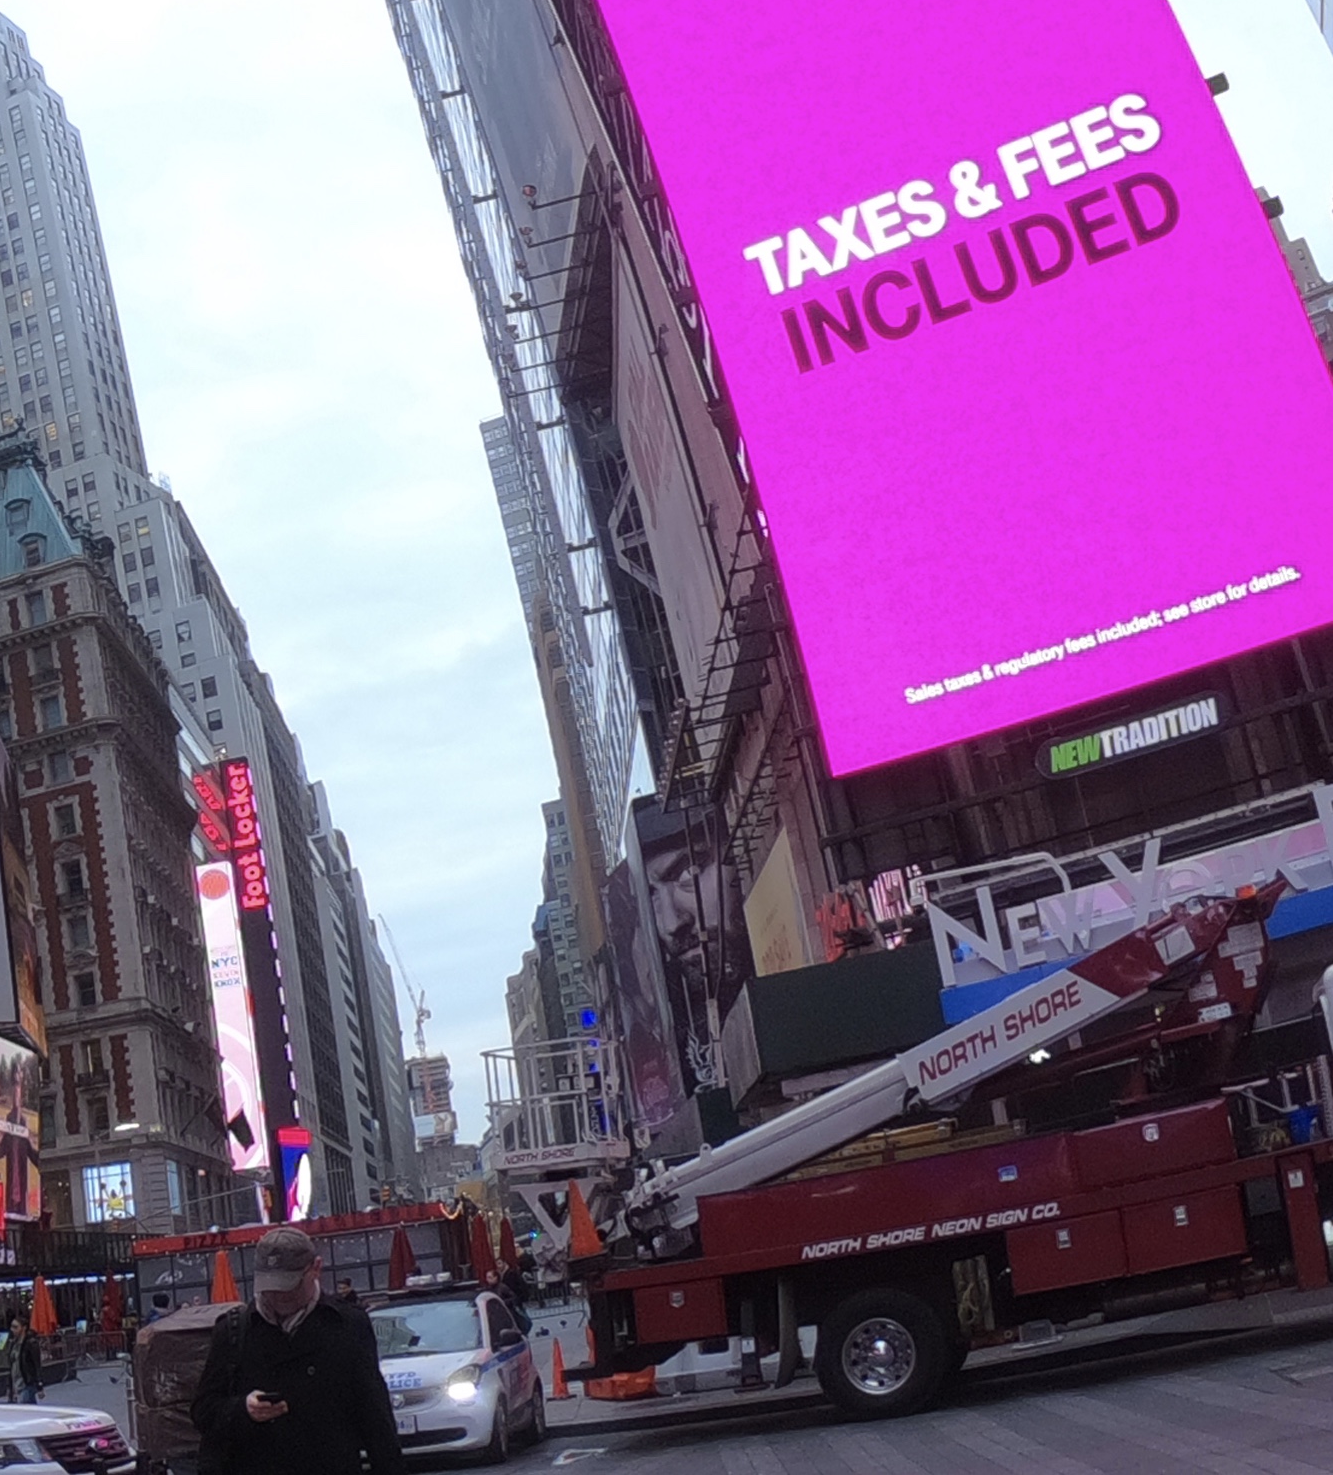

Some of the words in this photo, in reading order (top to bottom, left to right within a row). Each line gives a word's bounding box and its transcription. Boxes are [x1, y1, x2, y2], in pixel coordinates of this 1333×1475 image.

[742, 179, 948, 296] TAXES
[949, 159, 1003, 219] &
[996, 93, 1162, 201] FEES
[780, 171, 1181, 375] INCLUDED
[903, 681, 945, 706] Sales
[944, 670, 982, 693] taxes
[981, 663, 995, 681] &
[994, 639, 1066, 677] regulatory
[1064, 633, 1097, 655] fees
[1162, 602, 1191, 623] see
[1190, 589, 1228, 615] store
[1226, 580, 1248, 602] for
[1247, 565, 1302, 595] details.
[228, 762, 257, 850] Locker
[237, 851, 267, 910] Foot
[211, 955, 238, 969] NYC
[918, 1024, 998, 1086] NORTH
[1004, 980, 1082, 1042] SHORE
[504, 1152, 538, 1166] NORTH
[541, 1146, 575, 1161] SHORE
[183, 1232, 229, 1251] PIZZA
[800, 1237, 862, 1260] NORTH
[865, 1226, 927, 1249] SHORE
[930, 1215, 983, 1239] NEON
[985, 1207, 1029, 1229] SIGN
[1031, 1201, 1061, 1221] CO.
[389, 1378, 422, 1388] LICE
